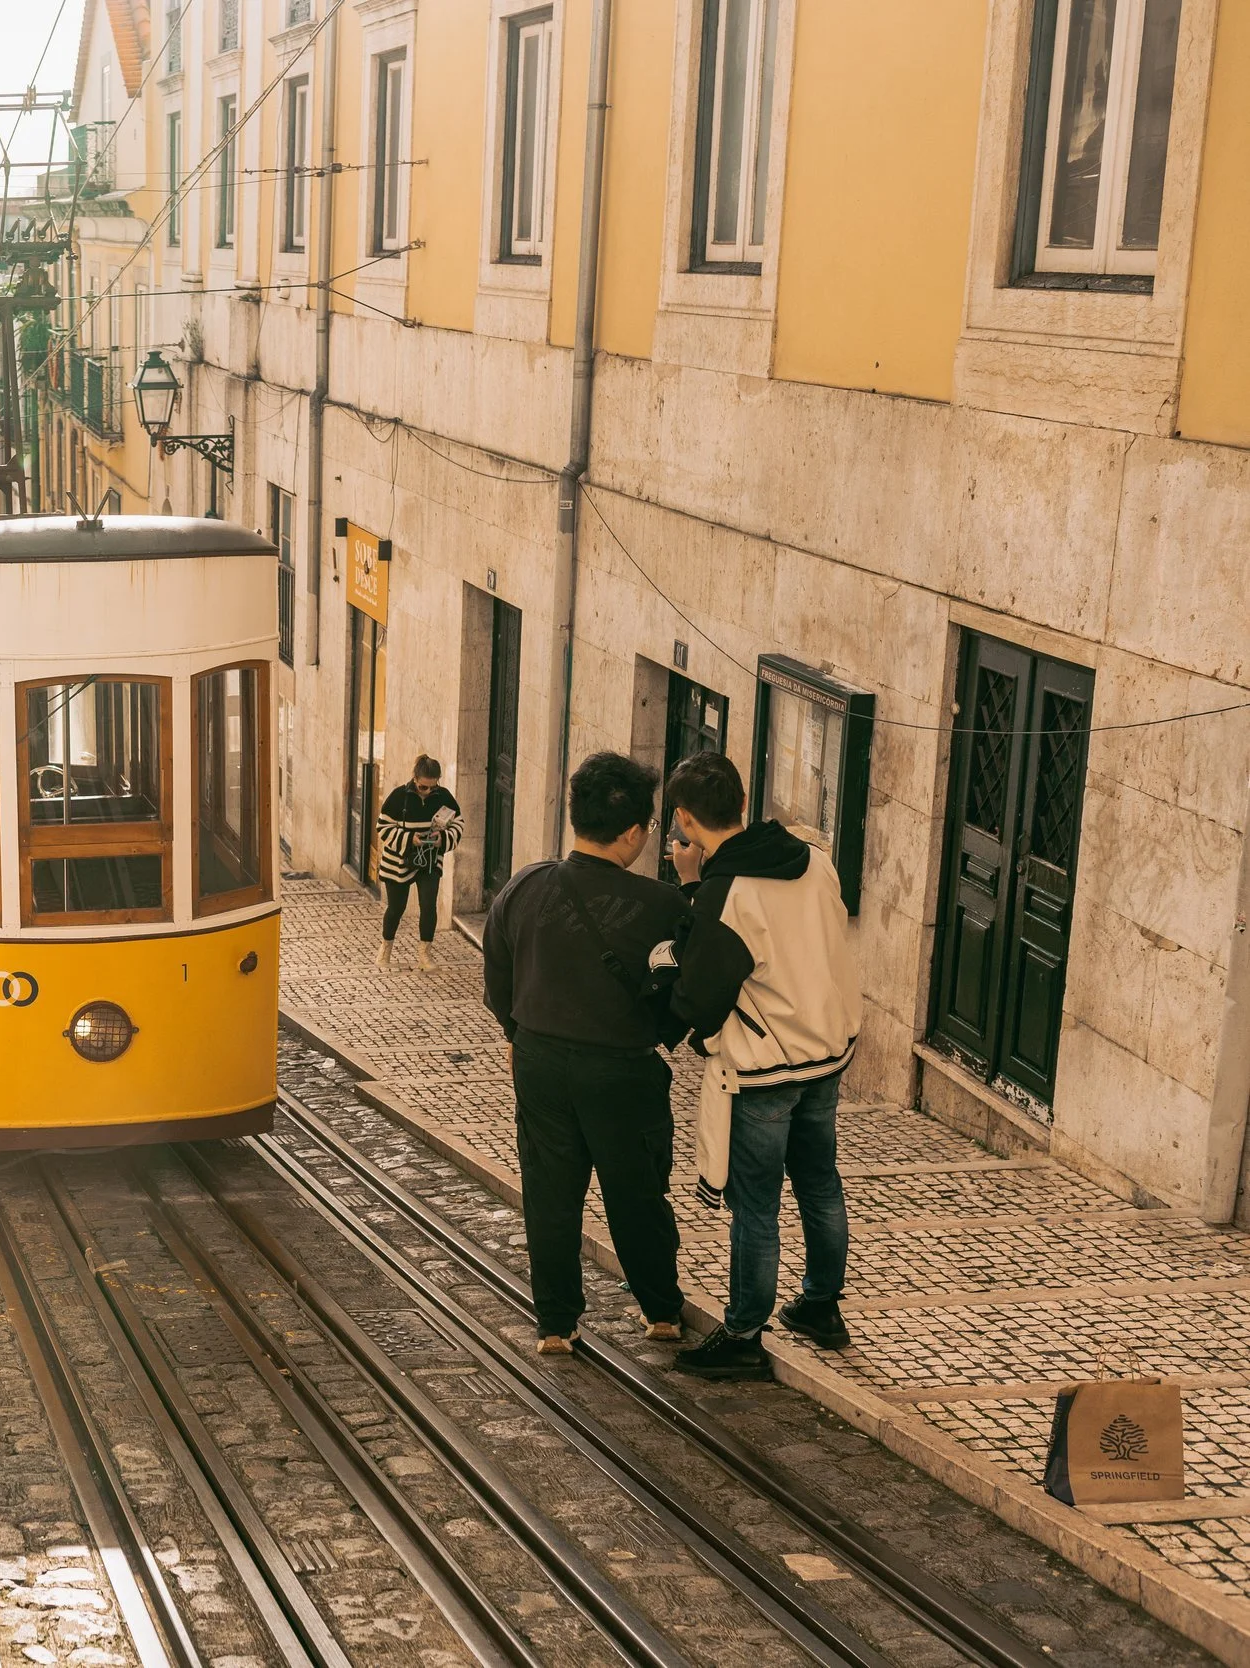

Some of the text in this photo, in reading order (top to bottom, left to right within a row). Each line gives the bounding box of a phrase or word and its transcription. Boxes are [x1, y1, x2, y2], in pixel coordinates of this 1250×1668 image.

[354, 540, 378, 573] SOBE
[354, 566, 378, 596] DESCE
[675, 644, 684, 666] 81
[761, 669, 845, 711] FREGUESIA DA MISERICÓRDIA
[181, 963, 188, 982] 1
[1090, 1471, 1160, 1481] SPRINGFIELD
